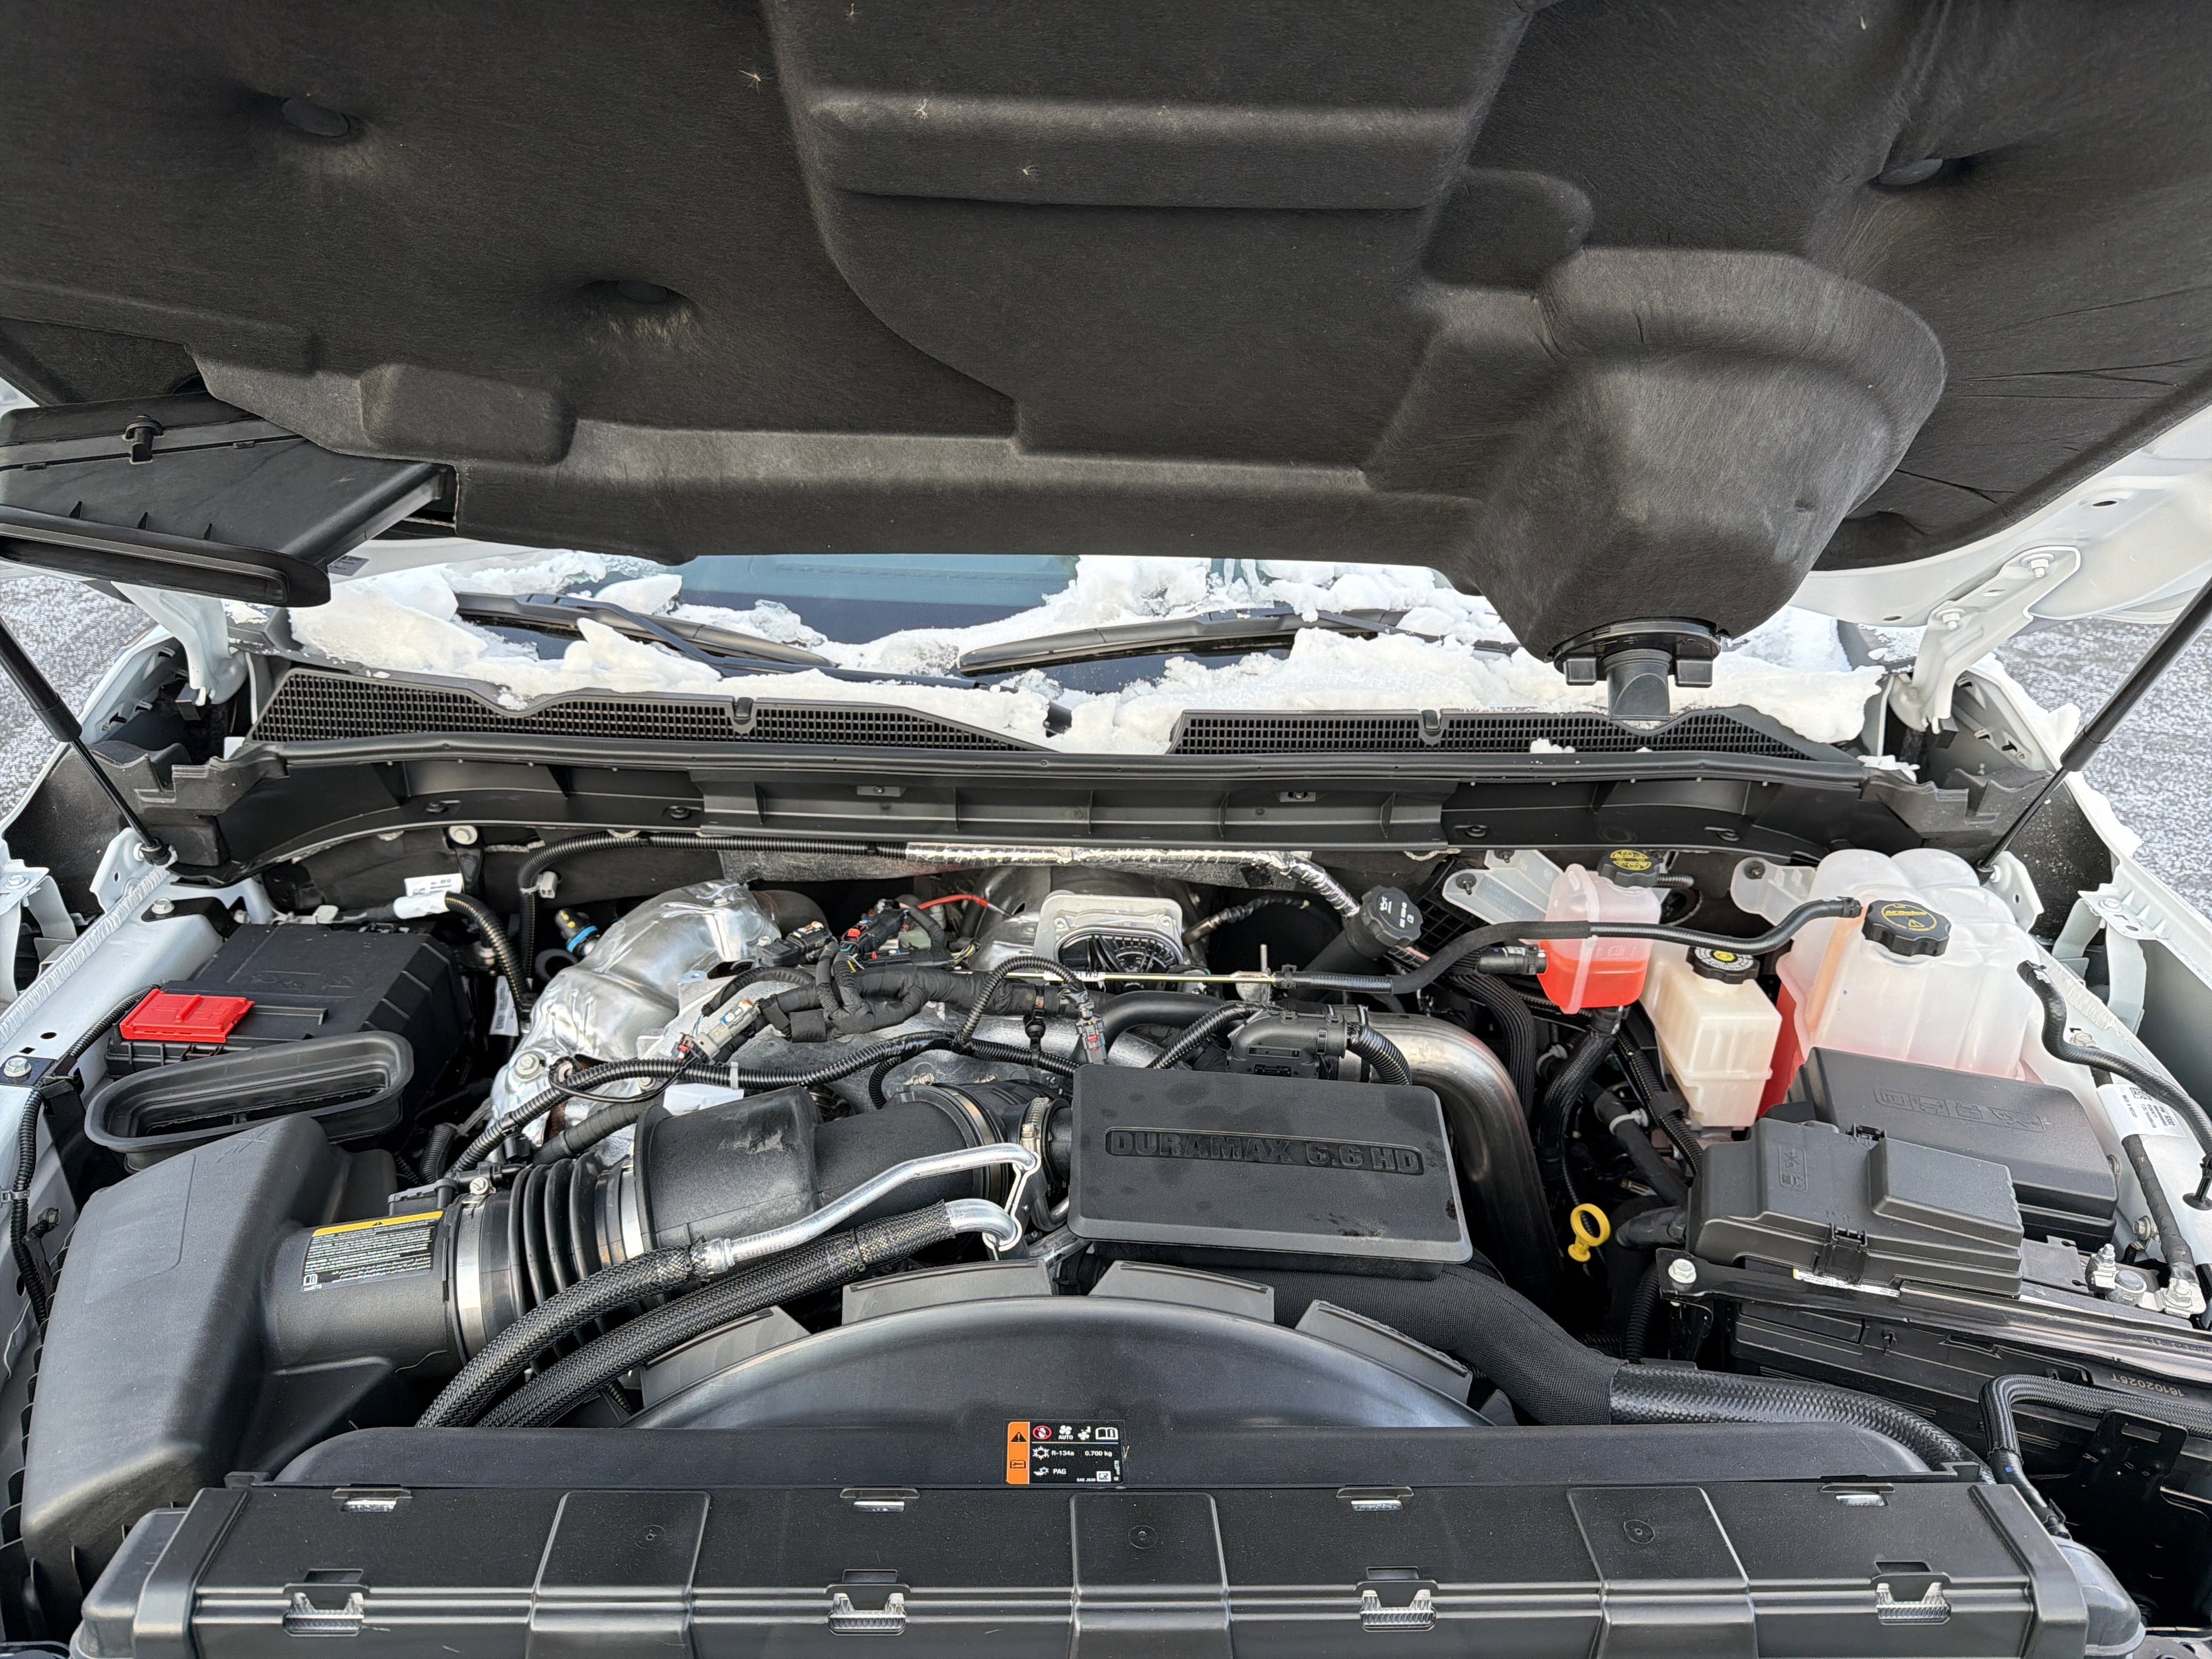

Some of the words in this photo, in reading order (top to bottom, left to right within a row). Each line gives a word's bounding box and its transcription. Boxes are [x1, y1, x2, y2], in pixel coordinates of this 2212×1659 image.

[1111, 1131, 1291, 1163] DURAMAX
[1305, 1143, 1363, 1167] 6.6
[1370, 1147, 1419, 1172] HD
[2111, 1373, 2185, 1397] 16102025T
